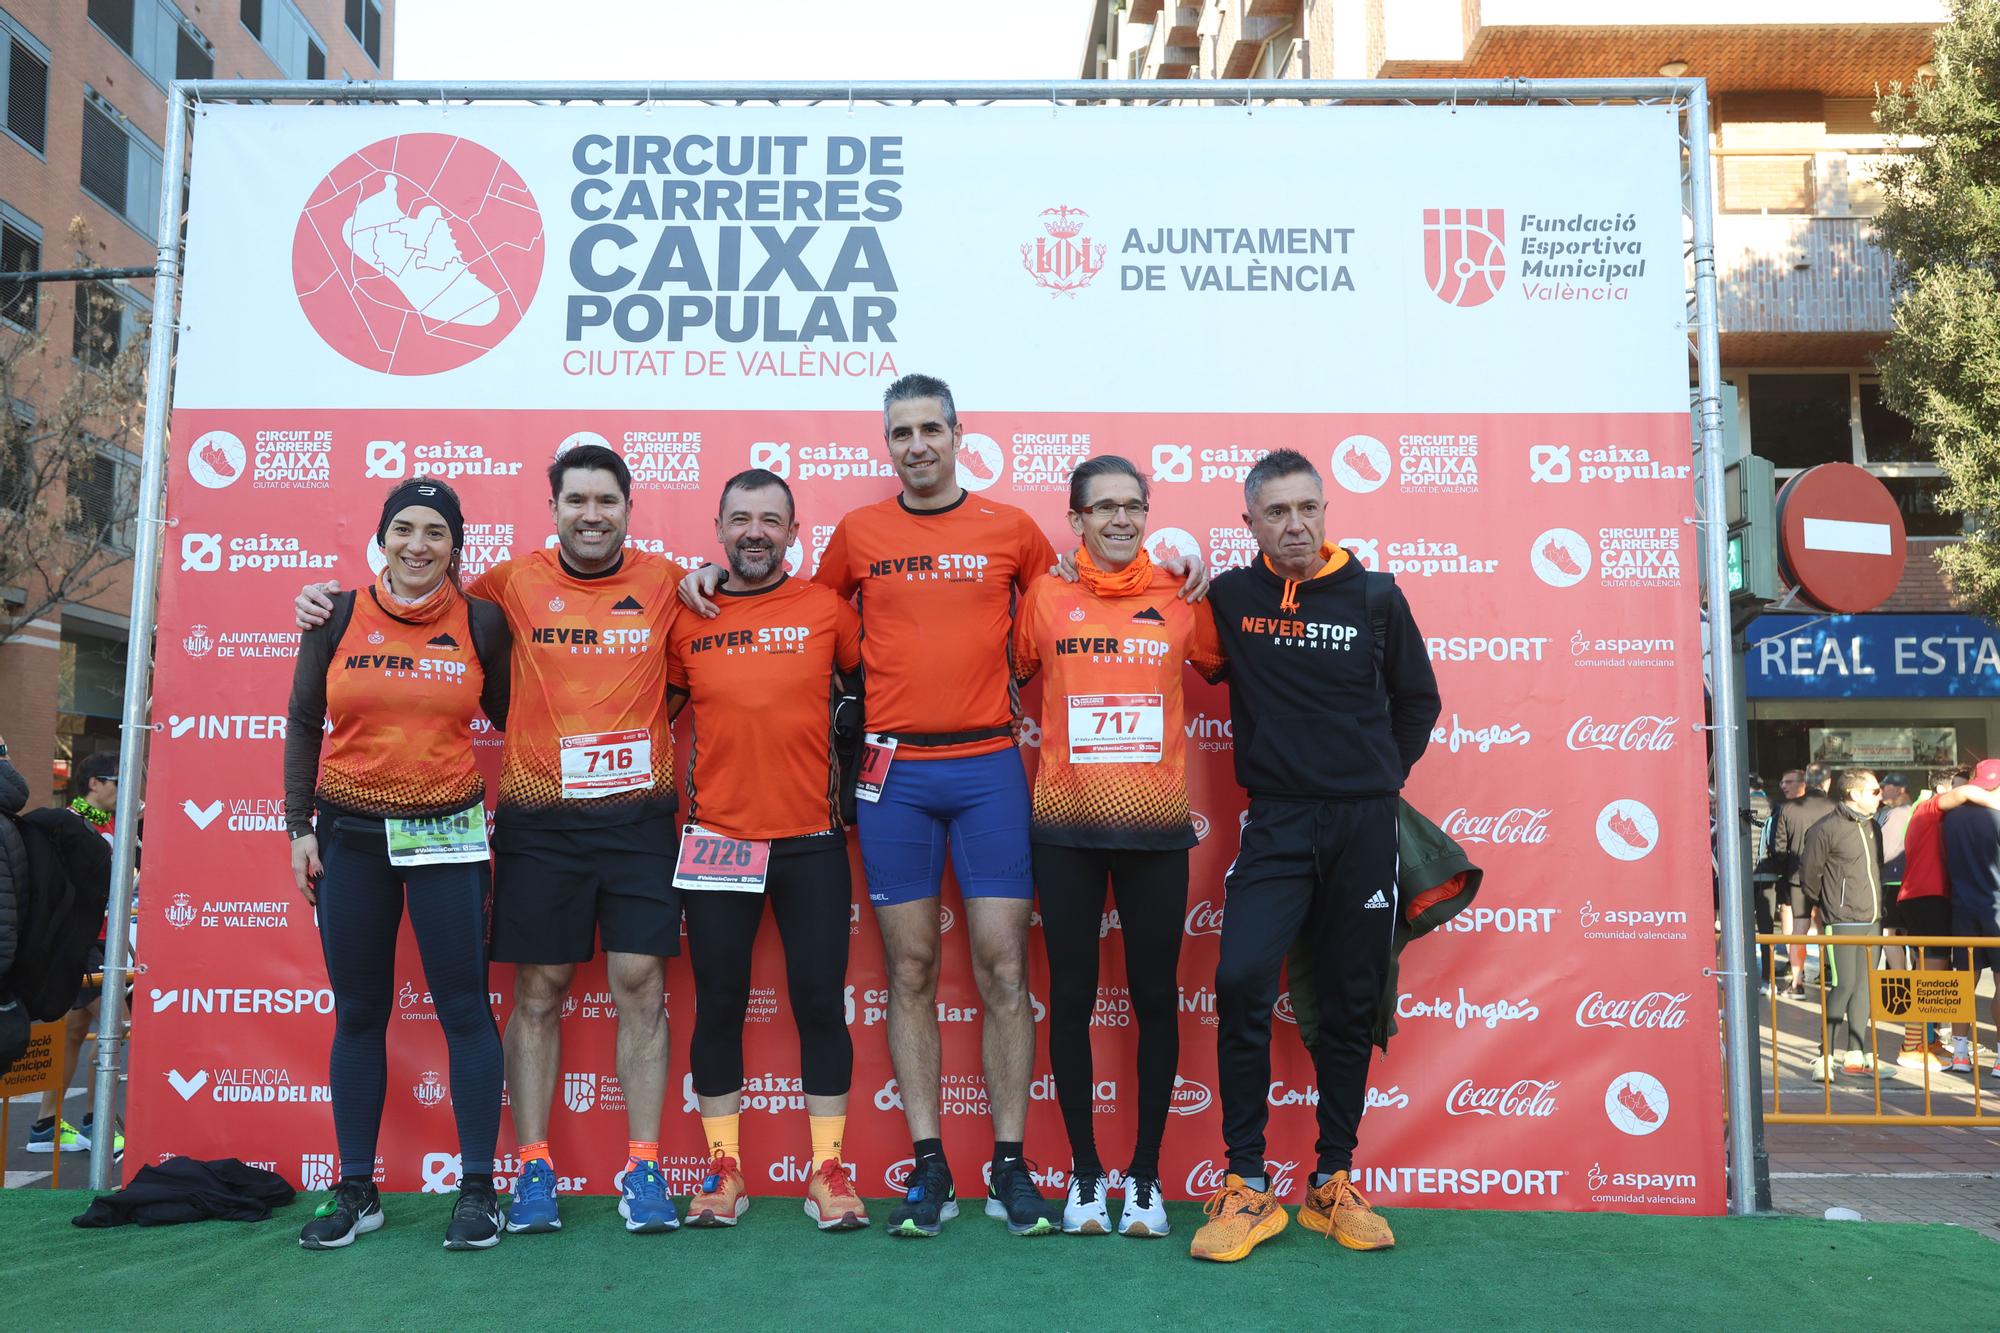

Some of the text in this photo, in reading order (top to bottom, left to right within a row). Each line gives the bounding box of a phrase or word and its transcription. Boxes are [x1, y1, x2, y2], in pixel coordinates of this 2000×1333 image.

[572, 134, 904, 176] CIRCUIT DE
[570, 178, 902, 222] CARRERES
[1520, 214, 1636, 232] Fundació
[1121, 228, 1355, 254] AJUNTAMENT
[1521, 236, 1641, 259] Esportiva
[569, 223, 899, 292] CAIXA
[1121, 259, 1355, 292] DE VALÈNCIA
[1522, 259, 1645, 282] Municipal
[1522, 282, 1628, 300] València
[566, 294, 898, 343] POPULAR
[563, 344, 898, 377] CIUTAT DE VALÈNCIA
[256, 431, 332, 441] CIRCUIT DE
[624, 432, 701, 442] CIRCUIT DE
[1012, 434, 1090, 444] CIRCUIT DE
[1399, 435, 1478, 445] CIRCUIT DE
[255, 441, 331, 452] CARRERES
[414, 440, 483, 458] caixa
[623, 443, 701, 452] CARRERES
[799, 443, 869, 459] caixa
[1012, 445, 1090, 455] CARRERES
[1399, 446, 1478, 457] CARRERES
[1578, 445, 1649, 462] caixa
[254, 452, 330, 469] CAIXA
[414, 457, 522, 478] popular
[625, 453, 699, 469] CAIXA
[1400, 457, 1477, 473] CAIXA
[254, 469, 329, 481] POPULAR
[798, 459, 898, 480] popula
[1579, 462, 1691, 483] popular
[1400, 473, 1478, 485] POPULAR
[495, 524, 514, 534] DE
[1210, 528, 1252, 537] CIRCU
[1599, 528, 1679, 538] CIRCUIT DE
[229, 533, 299, 551] caixa
[1210, 539, 1259, 549] CARRE
[1387, 538, 1458, 556] caixa
[1600, 539, 1679, 550] CARRERES
[228, 552, 338, 572] popular
[869, 554, 988, 577] NEVER STOP
[1388, 556, 1498, 577] popular
[1601, 551, 1679, 567] CAIXA
[907, 571, 983, 581] RUNNING
[1601, 567, 1680, 579] POPULAR
[219, 633, 302, 643] AJUNTAMENT
[532, 628, 598, 644] NEVER
[691, 627, 809, 654] NEVER STOP
[218, 647, 235, 657] DE
[571, 646, 648, 655] RUNNING
[727, 643, 804, 655] RUNNING
[1056, 638, 1169, 657] NEVER STOP
[1275, 638, 1351, 651] RUNNING
[1595, 637, 1674, 653] aspaym
[1575, 658, 1674, 667] comunidad valenciana
[1760, 637, 1875, 676] REAL
[345, 656, 466, 676] NEVER STOP
[385, 671, 462, 684] RUNNING
[1092, 712, 1141, 734] 717
[1450, 714, 1530, 752] Inglés
[1567, 716, 1680, 751] Coca-Cola
[584, 748, 632, 772] 716
[1442, 808, 1552, 843] Coca-Cola
[693, 839, 752, 866] 2726
[202, 902, 289, 913] AJUNTAMENT
[201, 914, 288, 928] DE VALÈNCIA
[1605, 909, 1687, 927] aspaym
[1584, 930, 1687, 940] comunidad valenciana
[1917, 979, 1958, 987] Fundació
[1917, 988, 1958, 996] Esportiva
[182, 989, 334, 1014] INTERSPO
[1396, 988, 1539, 1029] Corte Inglés
[1918, 997, 1961, 1006] Municipal
[583, 1008, 599, 1018] DE
[1575, 992, 1692, 1029] Coca-Cola
[214, 1069, 289, 1085] VALENCIA
[213, 1086, 274, 1102] CIUDAD
[278, 1086, 308, 1102] DEL
[1269, 1081, 1320, 1106] Corte
[1446, 1079, 1561, 1117] Coca-Cola
[1365, 1168, 1562, 1195] INTERSPORT
[1613, 1172, 1696, 1190] aspaym
[1592, 1194, 1696, 1204] comunidad valenciana
